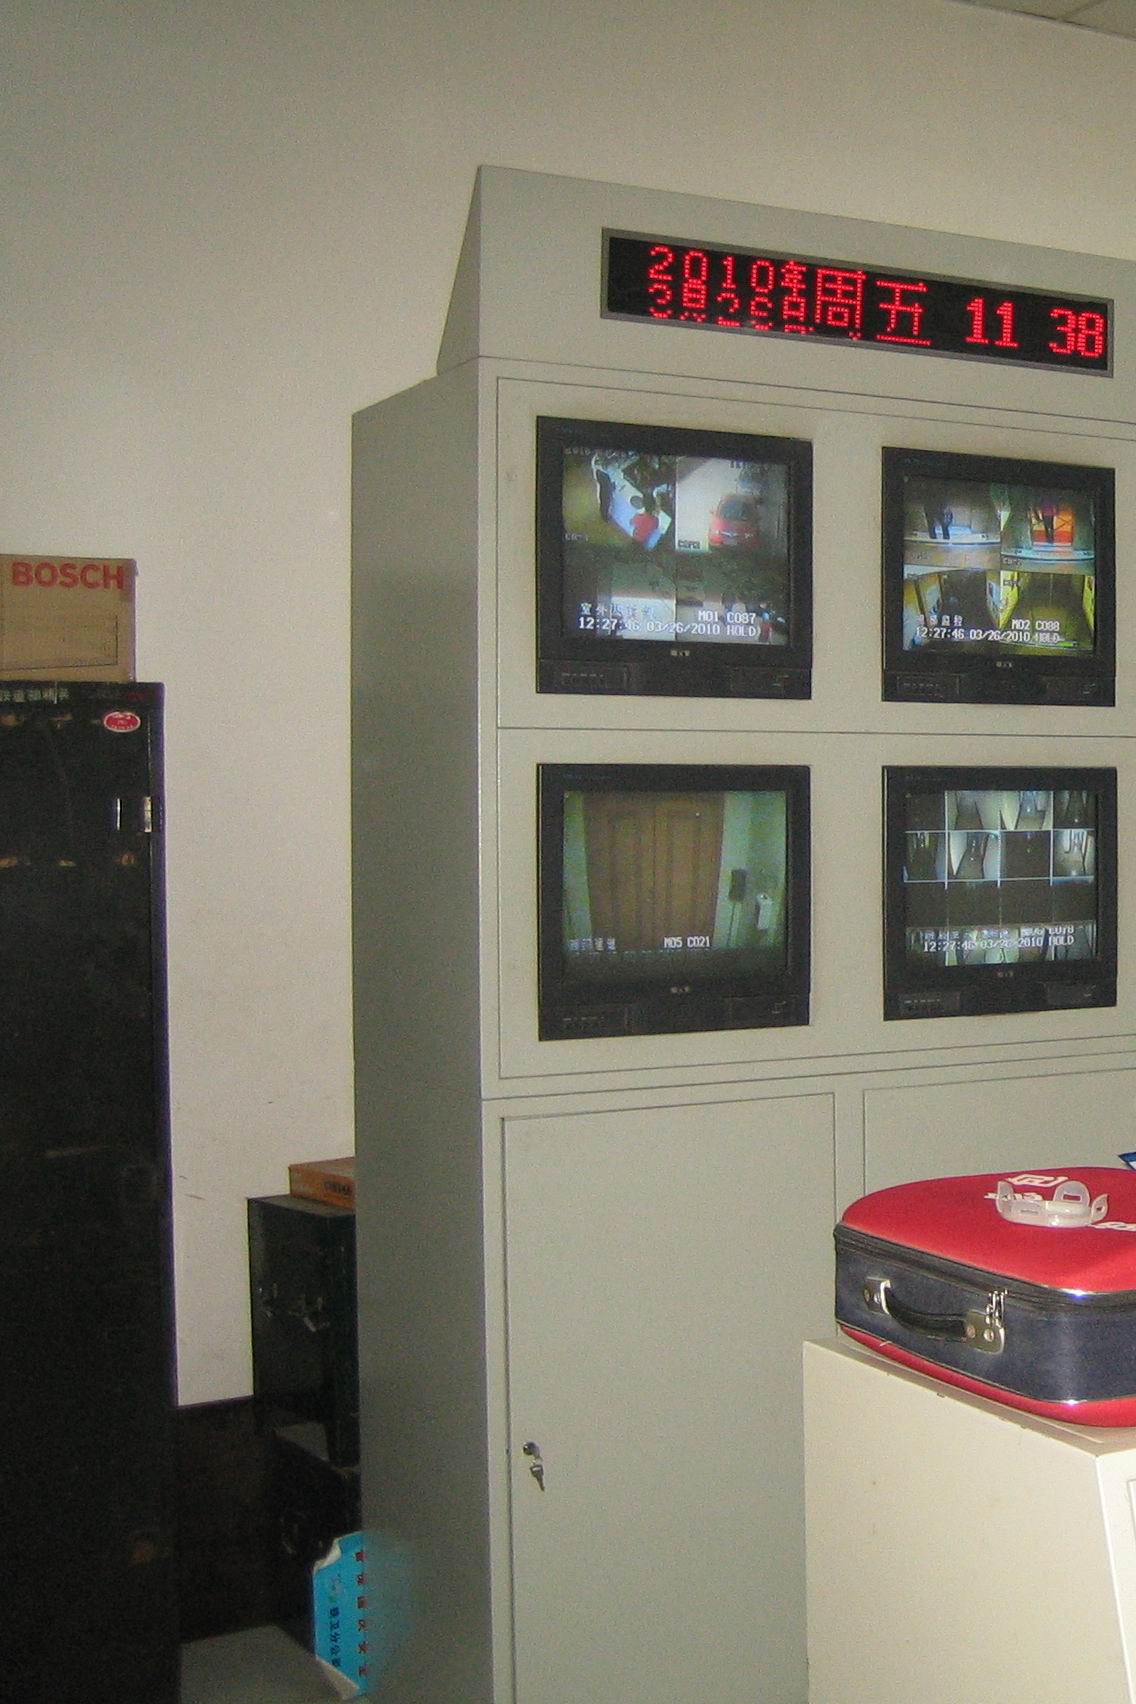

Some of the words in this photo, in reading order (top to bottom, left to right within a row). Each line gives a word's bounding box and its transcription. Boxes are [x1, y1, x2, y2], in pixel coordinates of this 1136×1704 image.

[965, 297, 1019, 347] 11
[1048, 307, 1105, 358] 38
[11, 562, 126, 590] BOSCH
[578, 616, 640, 631] 12:27:46
[647, 621, 721, 635] 03/26/2010
[969, 628, 1031, 642] 03/26/2010
[687, 935, 711, 948] C021
